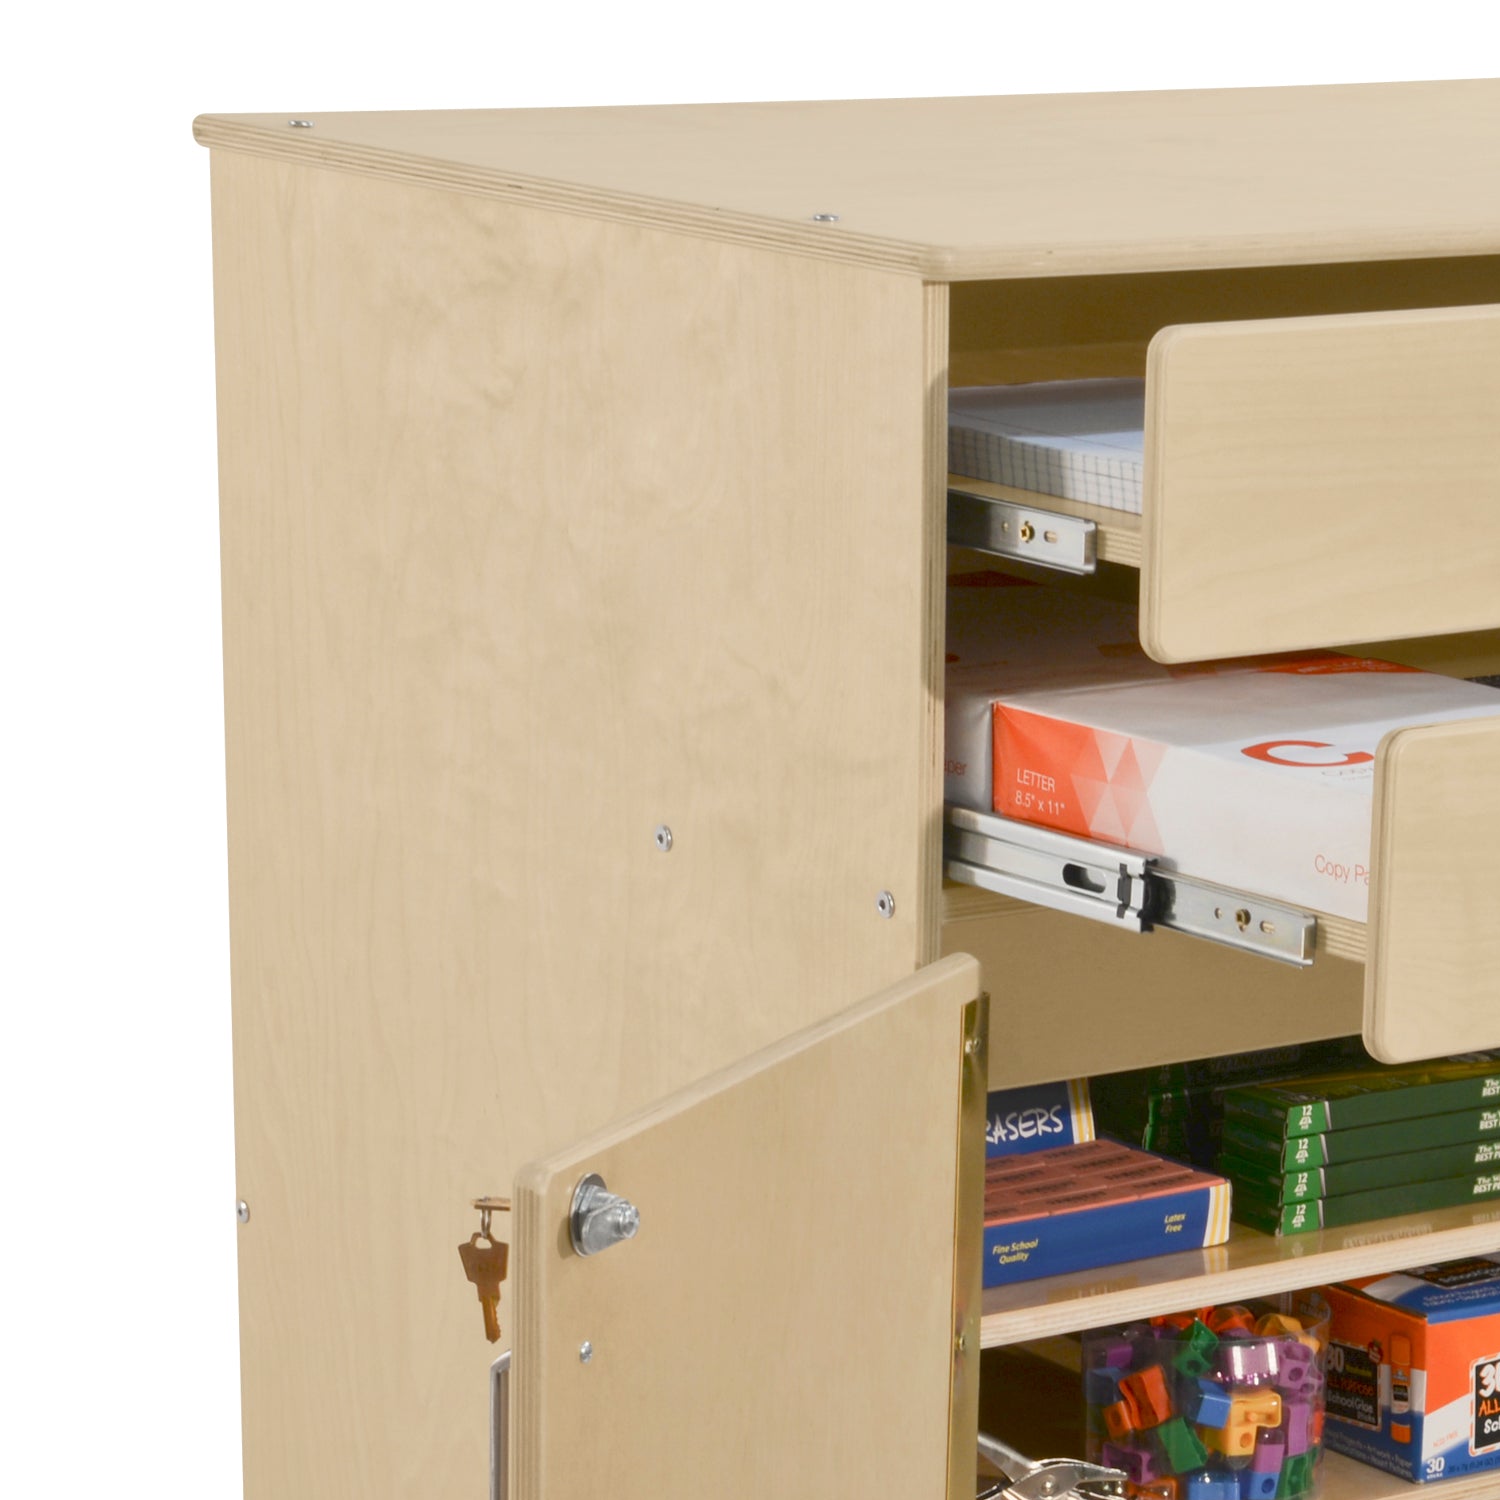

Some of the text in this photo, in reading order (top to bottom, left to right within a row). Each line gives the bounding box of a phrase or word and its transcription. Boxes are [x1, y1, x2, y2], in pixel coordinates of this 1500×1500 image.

[944, 759, 967, 776] per
[1017, 768, 1056, 793] LETTER
[1038, 799, 1046, 812] x
[1048, 799, 1066, 817] 11"
[1314, 854, 1351, 884] Copy
[1485, 1078, 1499, 1088] The
[1482, 1085, 1500, 1097] BEST
[1302, 1105, 1312, 1116] 12
[1482, 1112, 1496, 1121] The
[1479, 1119, 1498, 1131] BEST
[1298, 1138, 1309, 1149] 12
[1478, 1144, 1492, 1153] The
[1475, 1152, 1493, 1163] BEST
[1298, 1172, 1308, 1183] 12
[1477, 1177, 1491, 1185] The
[1473, 1183, 1492, 1194] BEST
[1296, 1204, 1306, 1215] 12
[992, 1238, 1039, 1255] Fine School
[999, 1252, 1029, 1265] Quality
[1426, 1456, 1445, 1474] 30
